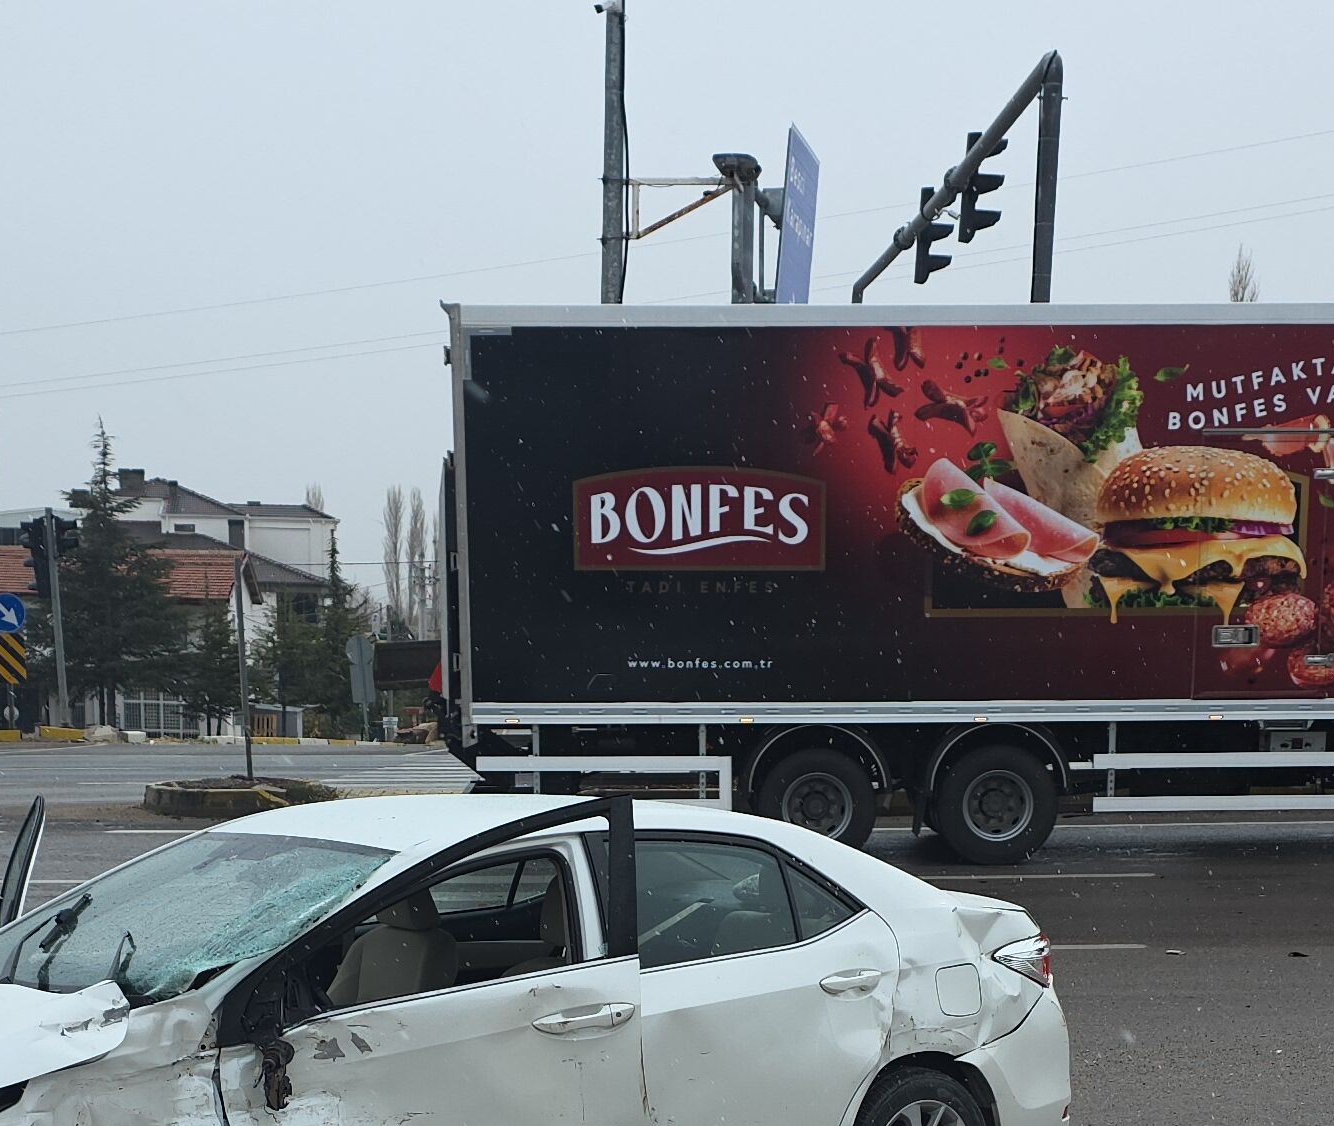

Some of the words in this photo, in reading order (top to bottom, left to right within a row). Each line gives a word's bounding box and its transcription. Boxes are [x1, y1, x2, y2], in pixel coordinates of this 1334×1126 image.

[1167, 393, 1287, 431] BONFES
[589, 483, 810, 546] BONFES
[700, 580, 776, 594] ENFES
[627, 657, 775, 670] www.bonfes.com.tr
